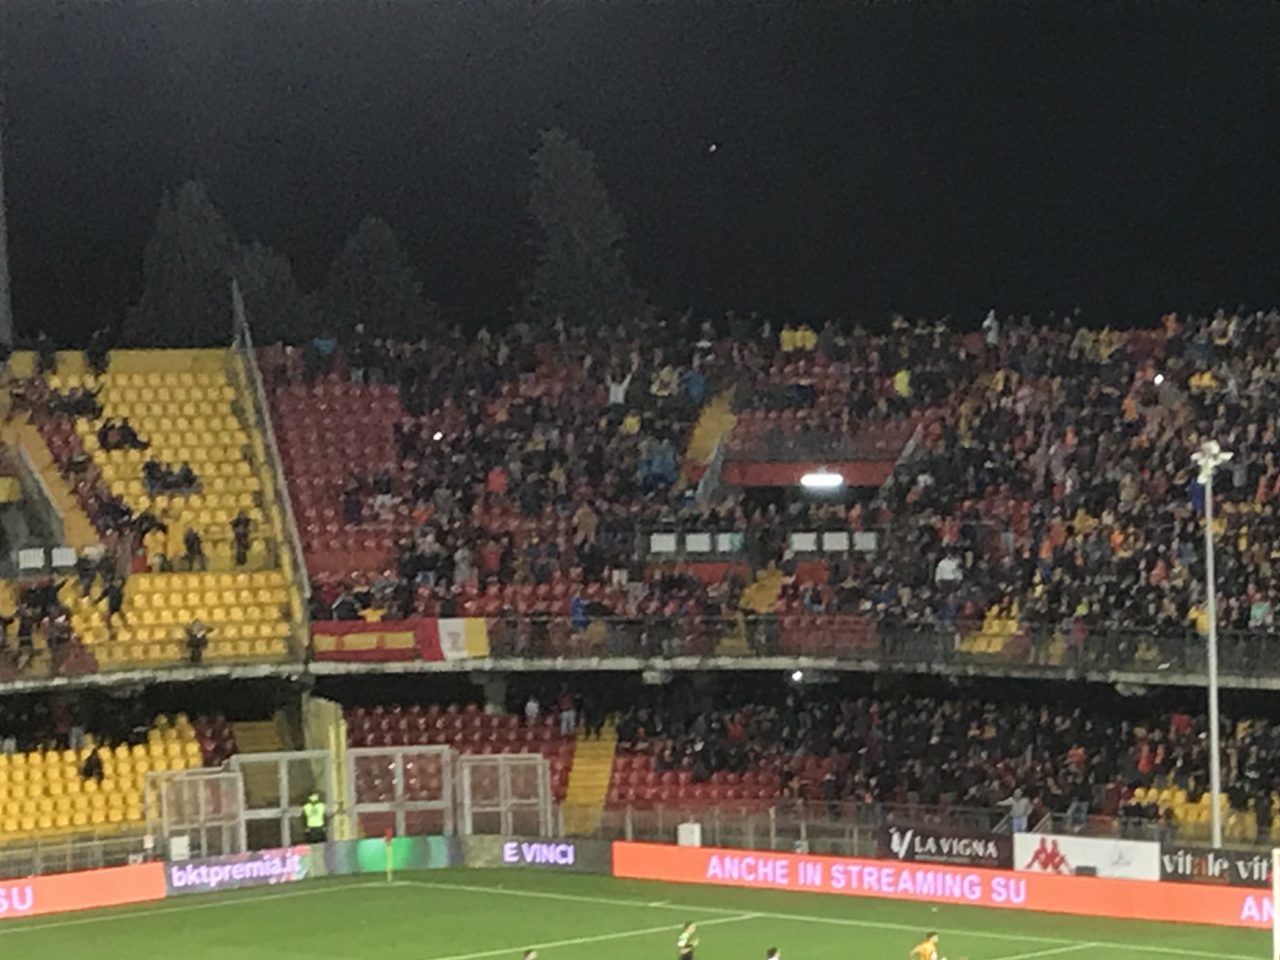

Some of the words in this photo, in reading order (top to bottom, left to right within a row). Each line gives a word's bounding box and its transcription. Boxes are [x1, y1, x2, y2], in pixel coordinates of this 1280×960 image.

[521, 843, 575, 865] VINCI
[913, 835, 937, 854] LA
[939, 837, 999, 859] VIGNA
[171, 851, 300, 888] bktpremia.it
[706, 855, 790, 885] ANCHE
[798, 861, 822, 887] IN
[830, 863, 983, 899] STREAMING
[991, 875, 1027, 904] SU
